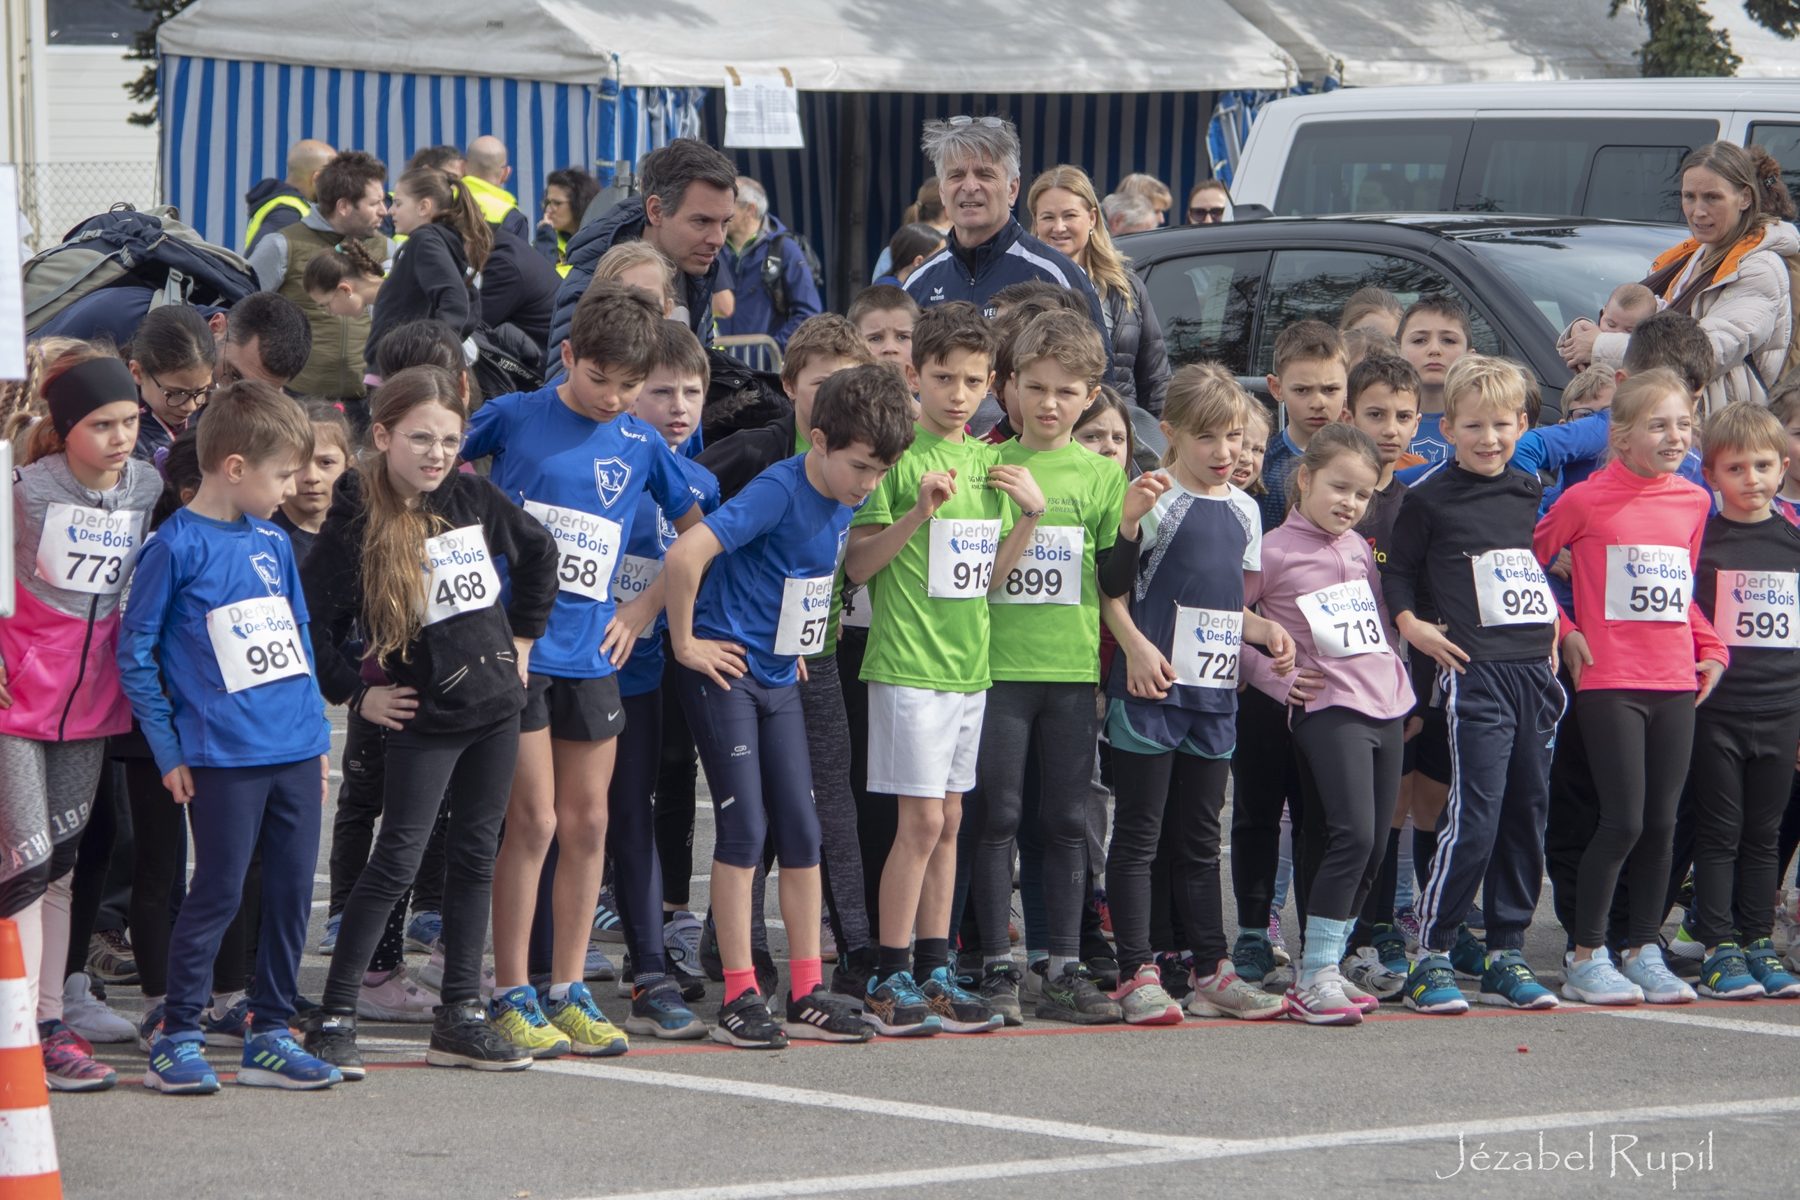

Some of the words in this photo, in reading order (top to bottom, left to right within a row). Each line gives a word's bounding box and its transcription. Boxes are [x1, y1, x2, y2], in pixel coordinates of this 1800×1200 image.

[71, 508, 123, 533] Derby
[546, 508, 599, 537] Derby
[952, 522, 996, 540] Derby
[80, 529, 133, 548] DesBois
[554, 528, 608, 555] DesBois
[962, 538, 998, 554] DesBoi
[1022, 546, 1071, 561] esBois
[1494, 552, 1533, 570] Derby
[1628, 548, 1674, 566] Derby
[66, 552, 122, 584] 773
[558, 552, 598, 588] 58
[954, 562, 992, 590] 913
[1506, 568, 1546, 583] DesBois
[1638, 564, 1686, 580] DesBois
[436, 571, 486, 606] 468
[1006, 568, 1062, 596] 899
[1736, 574, 1784, 592] Derby
[1315, 585, 1361, 604] Derby
[1332, 598, 1376, 612] DesBois
[1502, 589, 1548, 616] 923
[1630, 586, 1684, 613] 594
[1744, 590, 1795, 606] DesBois
[228, 604, 276, 624] Derby
[245, 616, 293, 634] DesBois
[1199, 612, 1239, 633] Derby
[1736, 612, 1790, 639] 593
[800, 616, 826, 646] 57
[1334, 618, 1380, 648] 713
[246, 638, 302, 675] 981
[1198, 652, 1237, 680] 722
